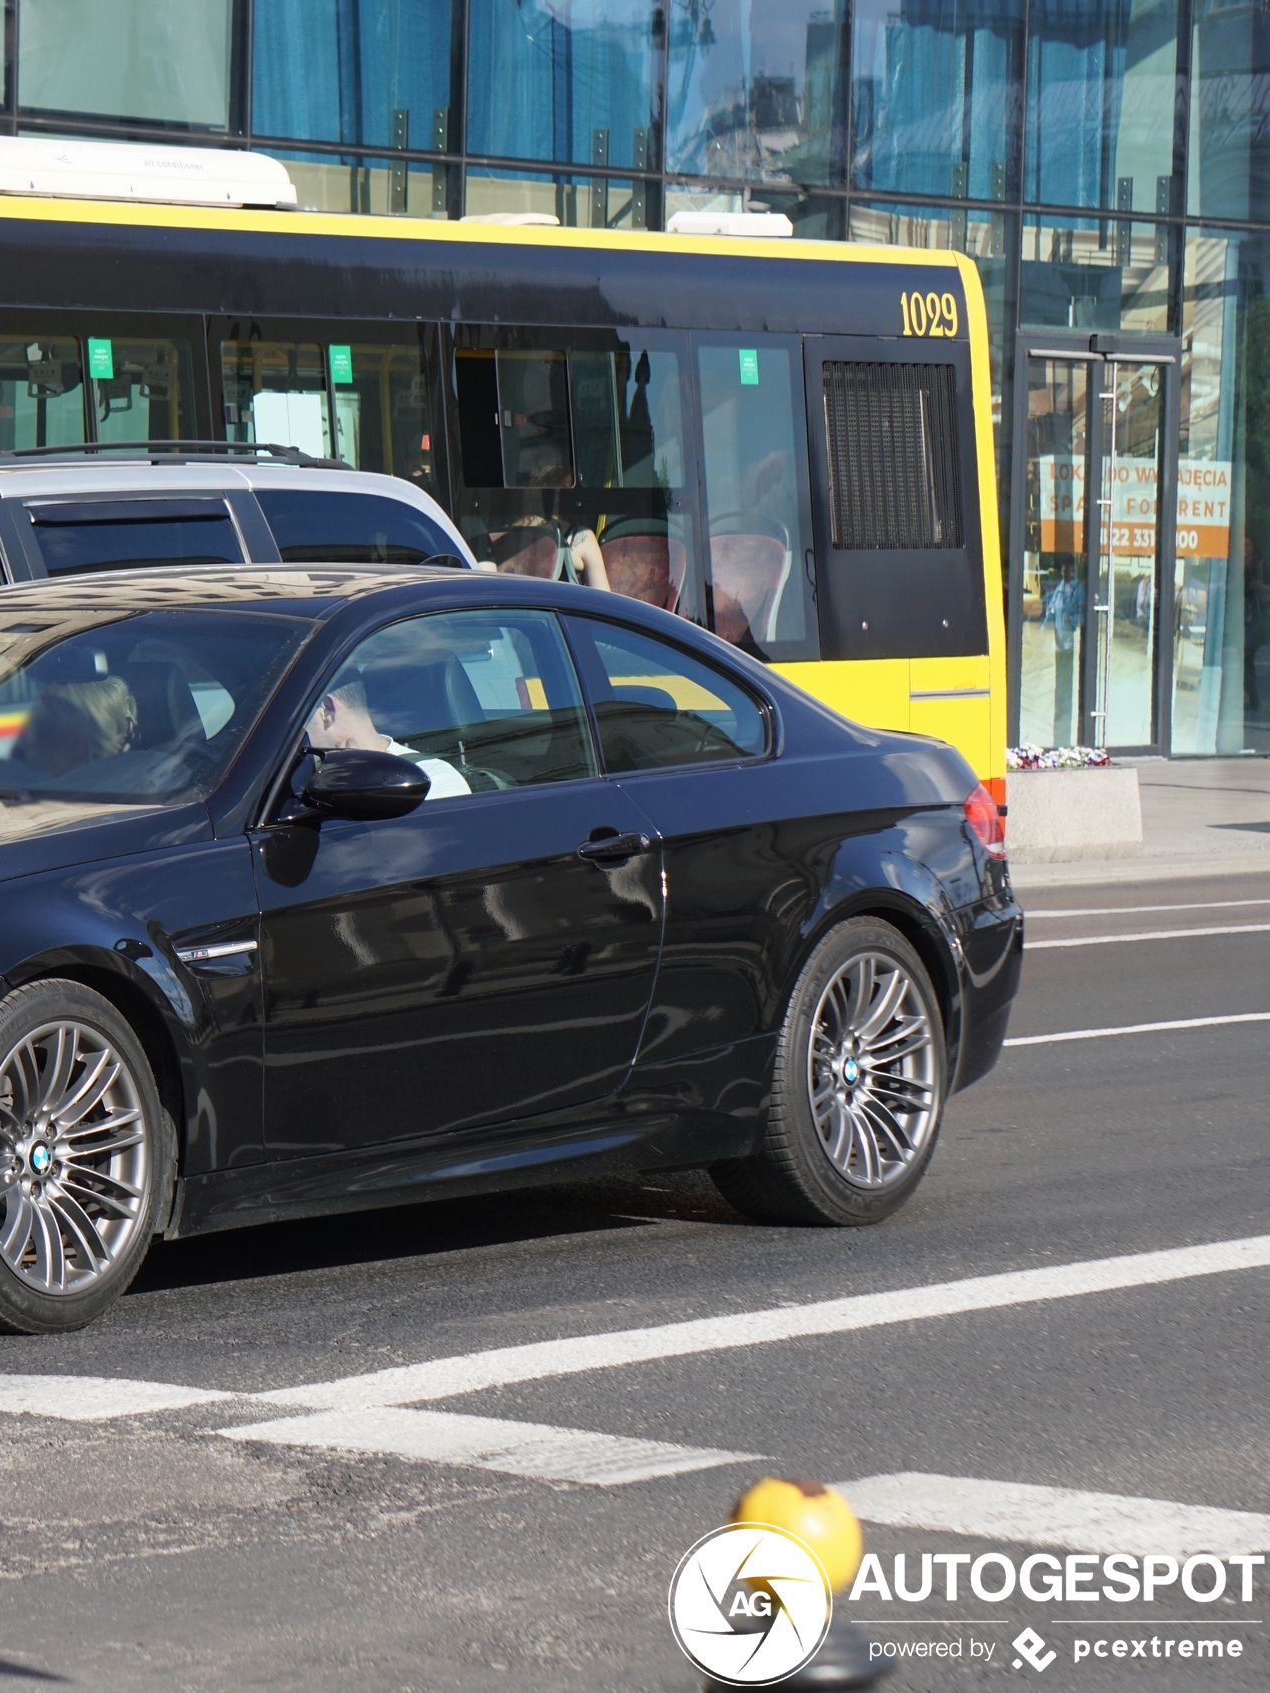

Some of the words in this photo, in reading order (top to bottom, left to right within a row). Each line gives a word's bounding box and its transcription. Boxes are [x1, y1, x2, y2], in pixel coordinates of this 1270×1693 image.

[143, 159, 204, 171] air-conditioner
[900, 291, 959, 337] 1029
[1179, 499, 1227, 518] RENT
